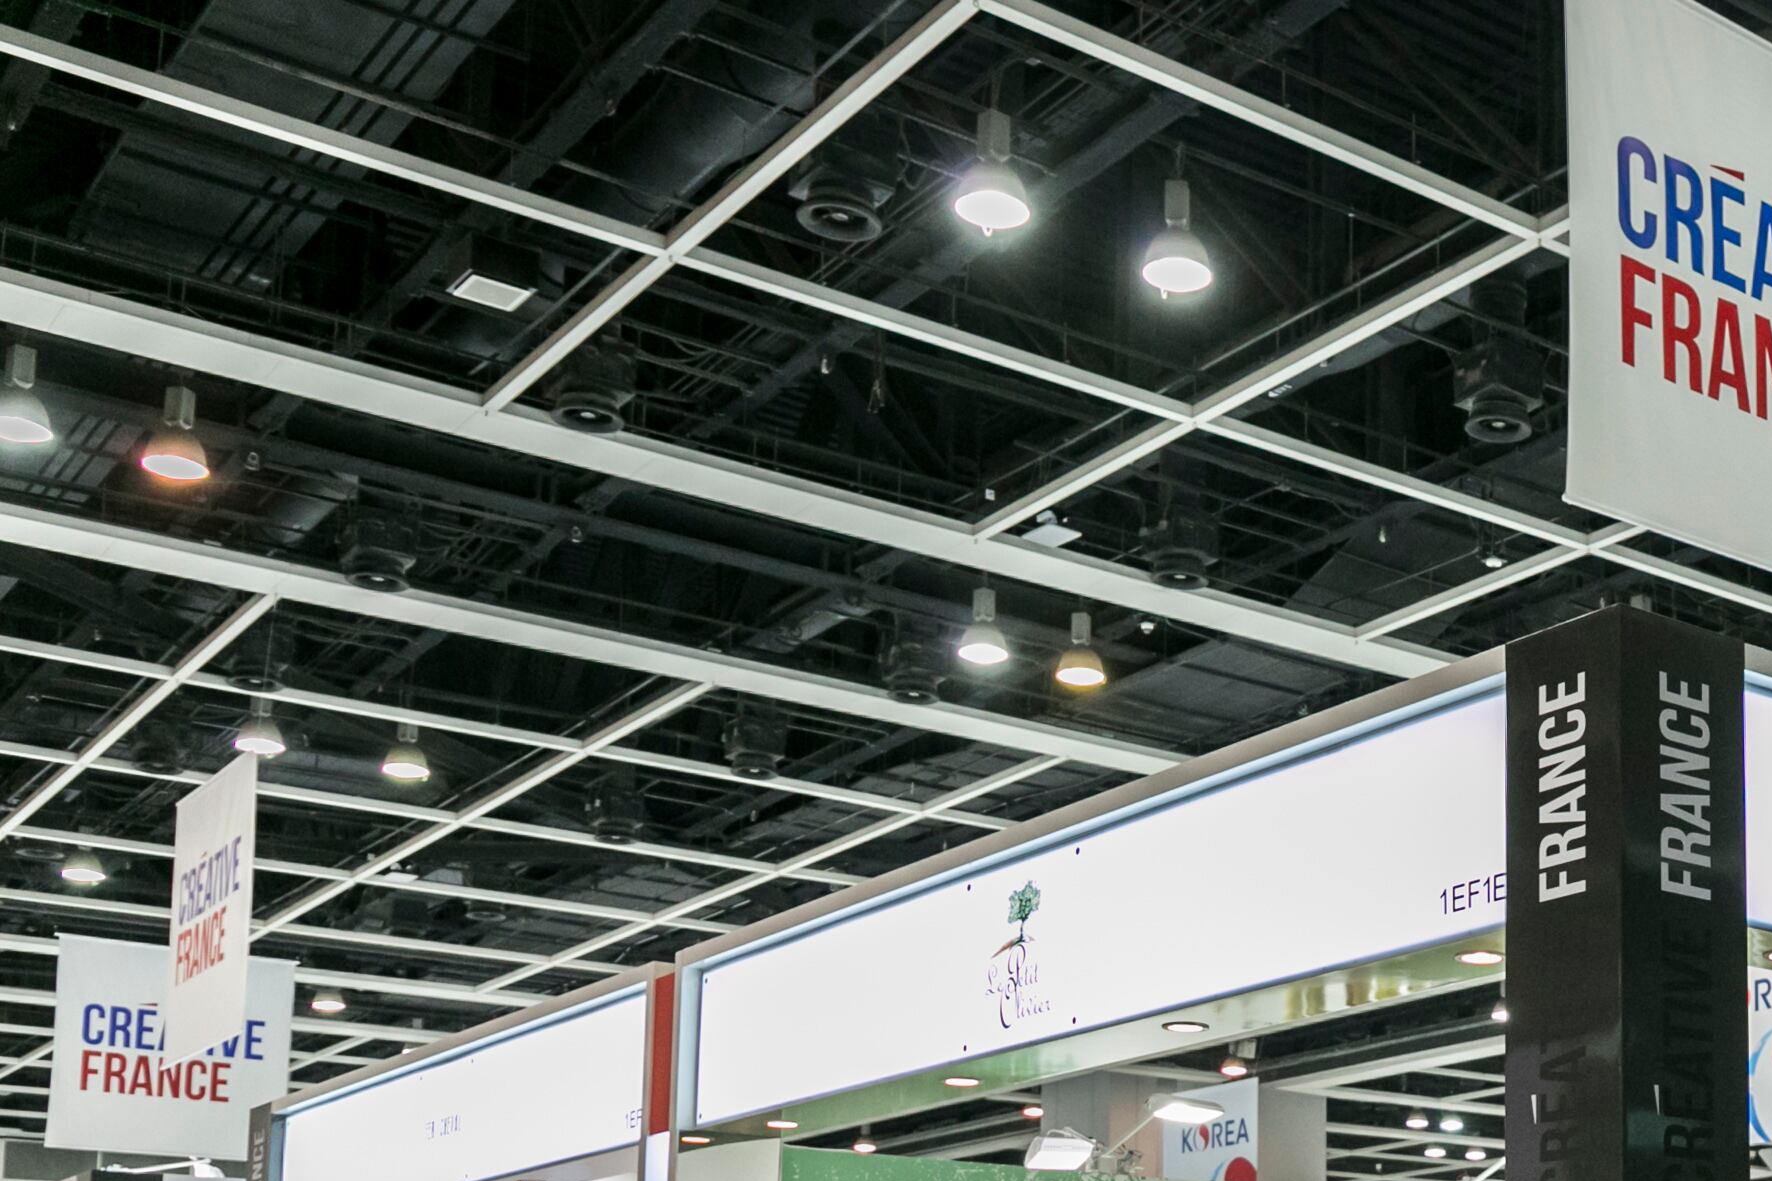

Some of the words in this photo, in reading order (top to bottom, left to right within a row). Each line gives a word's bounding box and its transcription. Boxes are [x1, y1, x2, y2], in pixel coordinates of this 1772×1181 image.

[1538, 671, 1586, 903] FRANCE
[1659, 670, 1711, 901] FRANCE
[175, 906, 227, 986] FRANCE
[985, 965, 1004, 996] Le
[79, 1050, 231, 1103] FRANCE
[1182, 1117, 1249, 1154] KOREA
